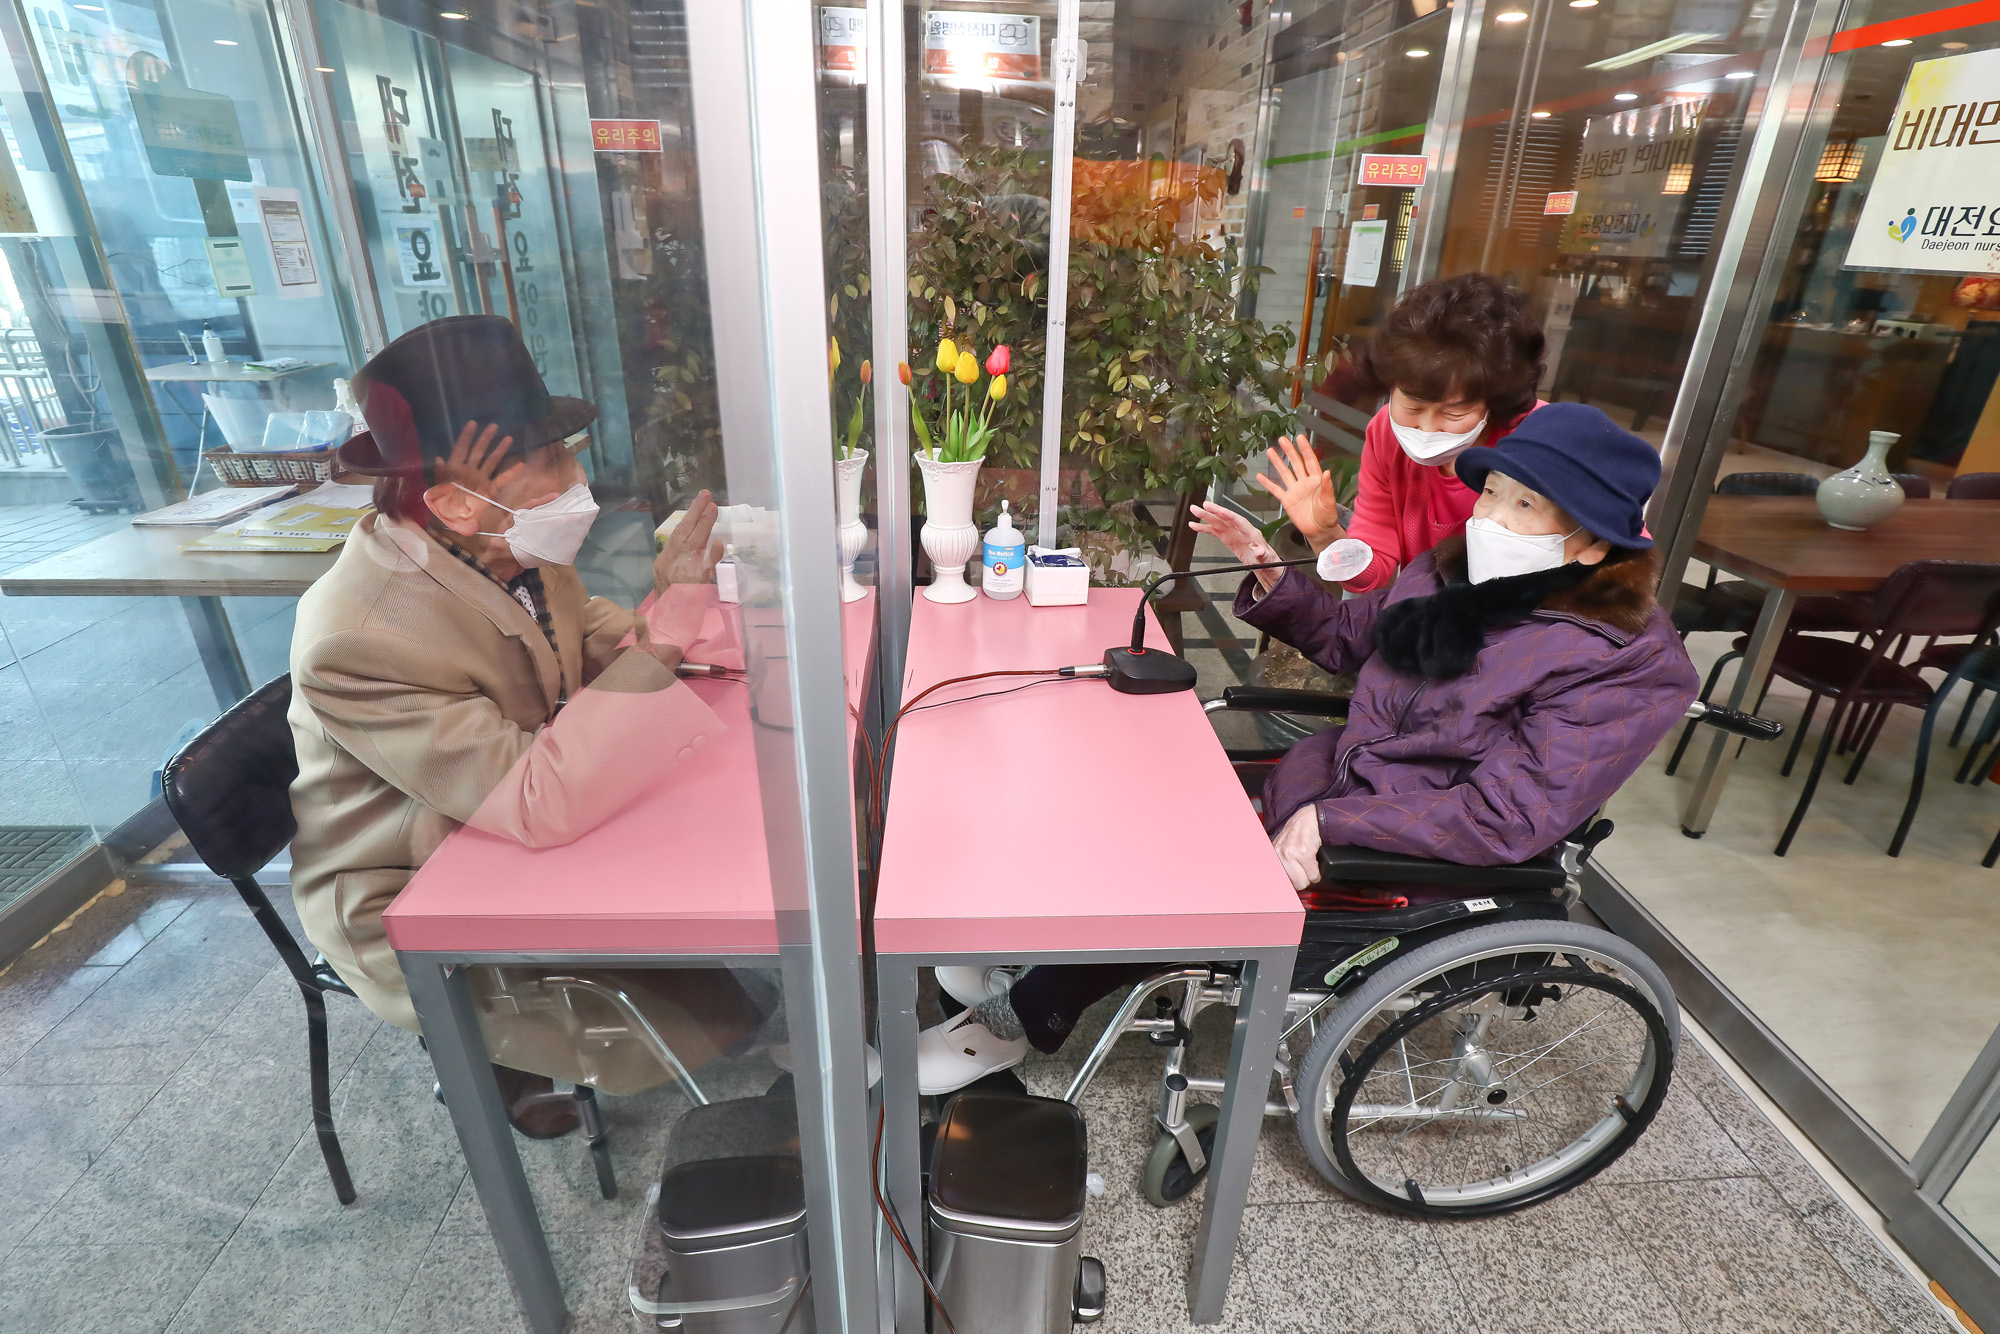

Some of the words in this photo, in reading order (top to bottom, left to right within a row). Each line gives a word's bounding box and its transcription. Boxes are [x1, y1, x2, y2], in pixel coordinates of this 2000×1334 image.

[596, 128, 657, 145] 유리주의
[1366, 163, 1423, 180] 유리주의
[1548, 198, 1572, 210] 유리주의
[1921, 239, 1970, 252] Daejeon
